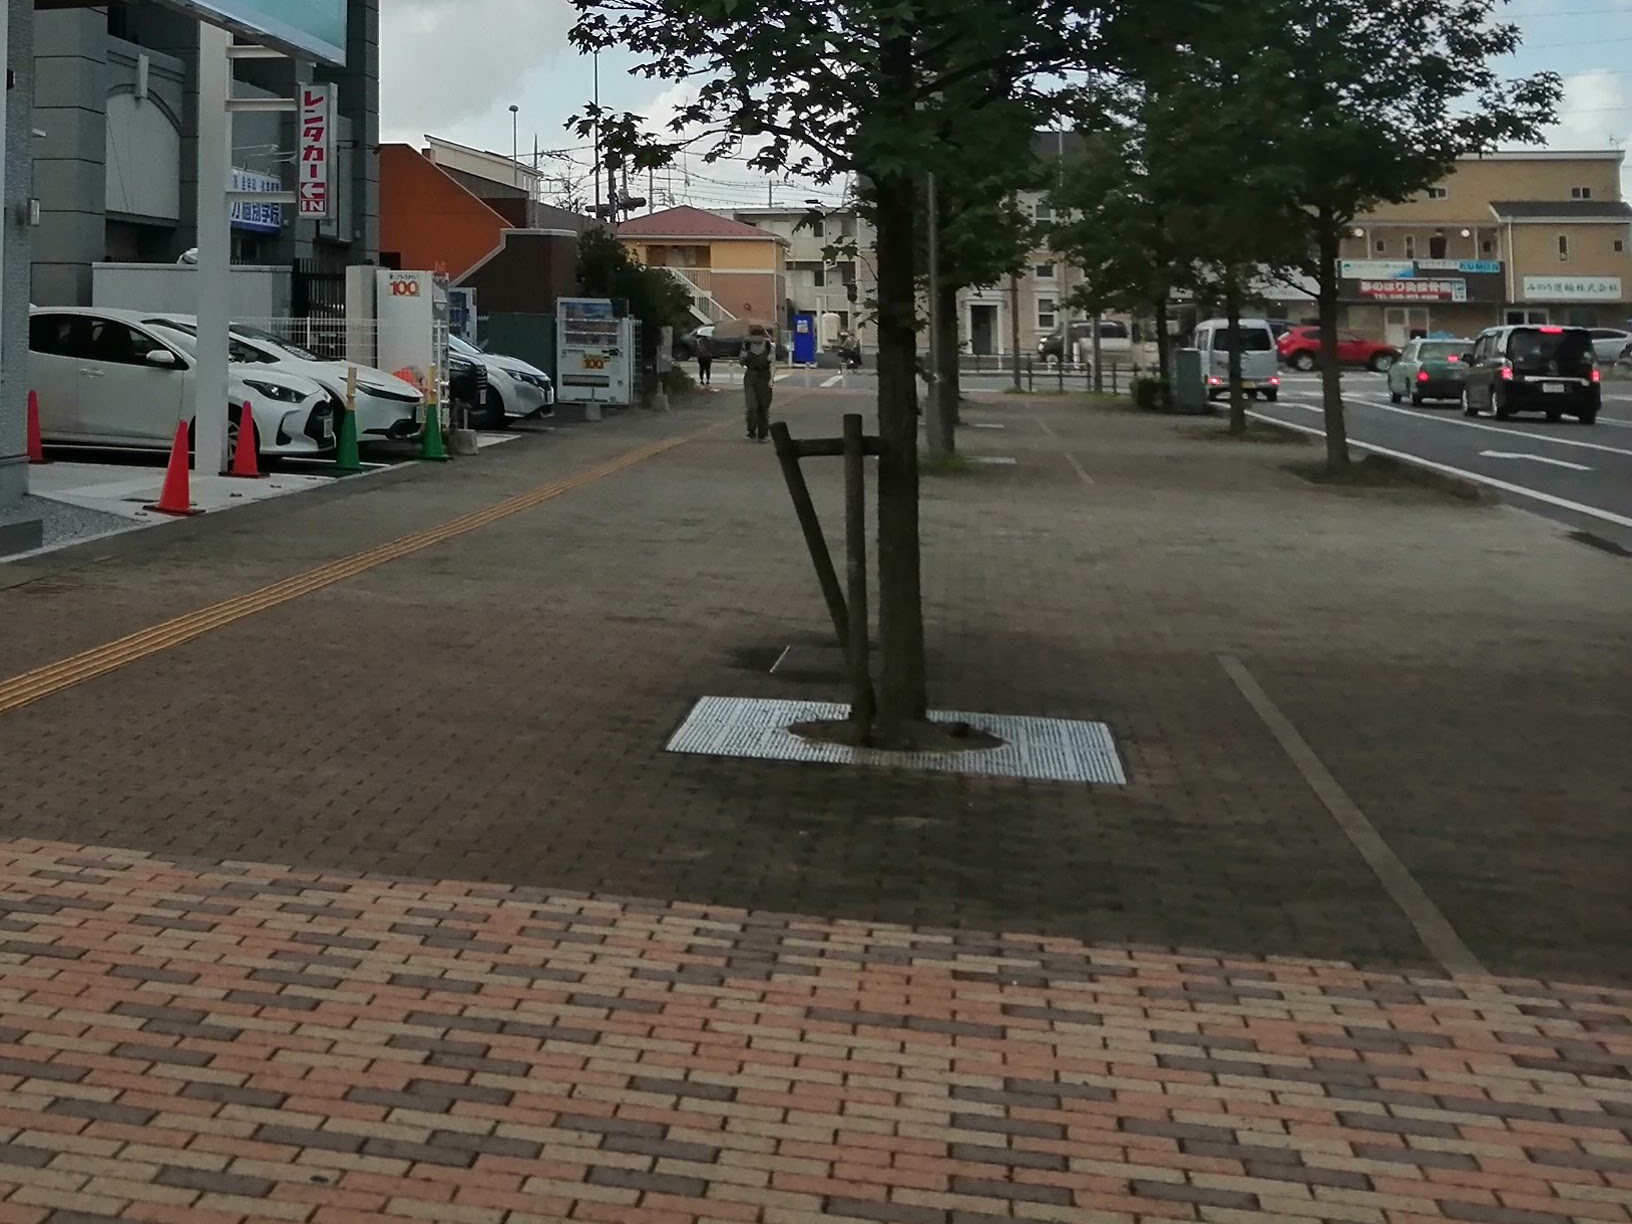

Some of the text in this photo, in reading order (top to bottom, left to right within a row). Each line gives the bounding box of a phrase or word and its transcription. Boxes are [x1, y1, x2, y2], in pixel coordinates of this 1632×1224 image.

[303, 90, 325, 179] レンタカー
[302, 200, 324, 212] IN
[1459, 261, 1500, 271] KUMON
